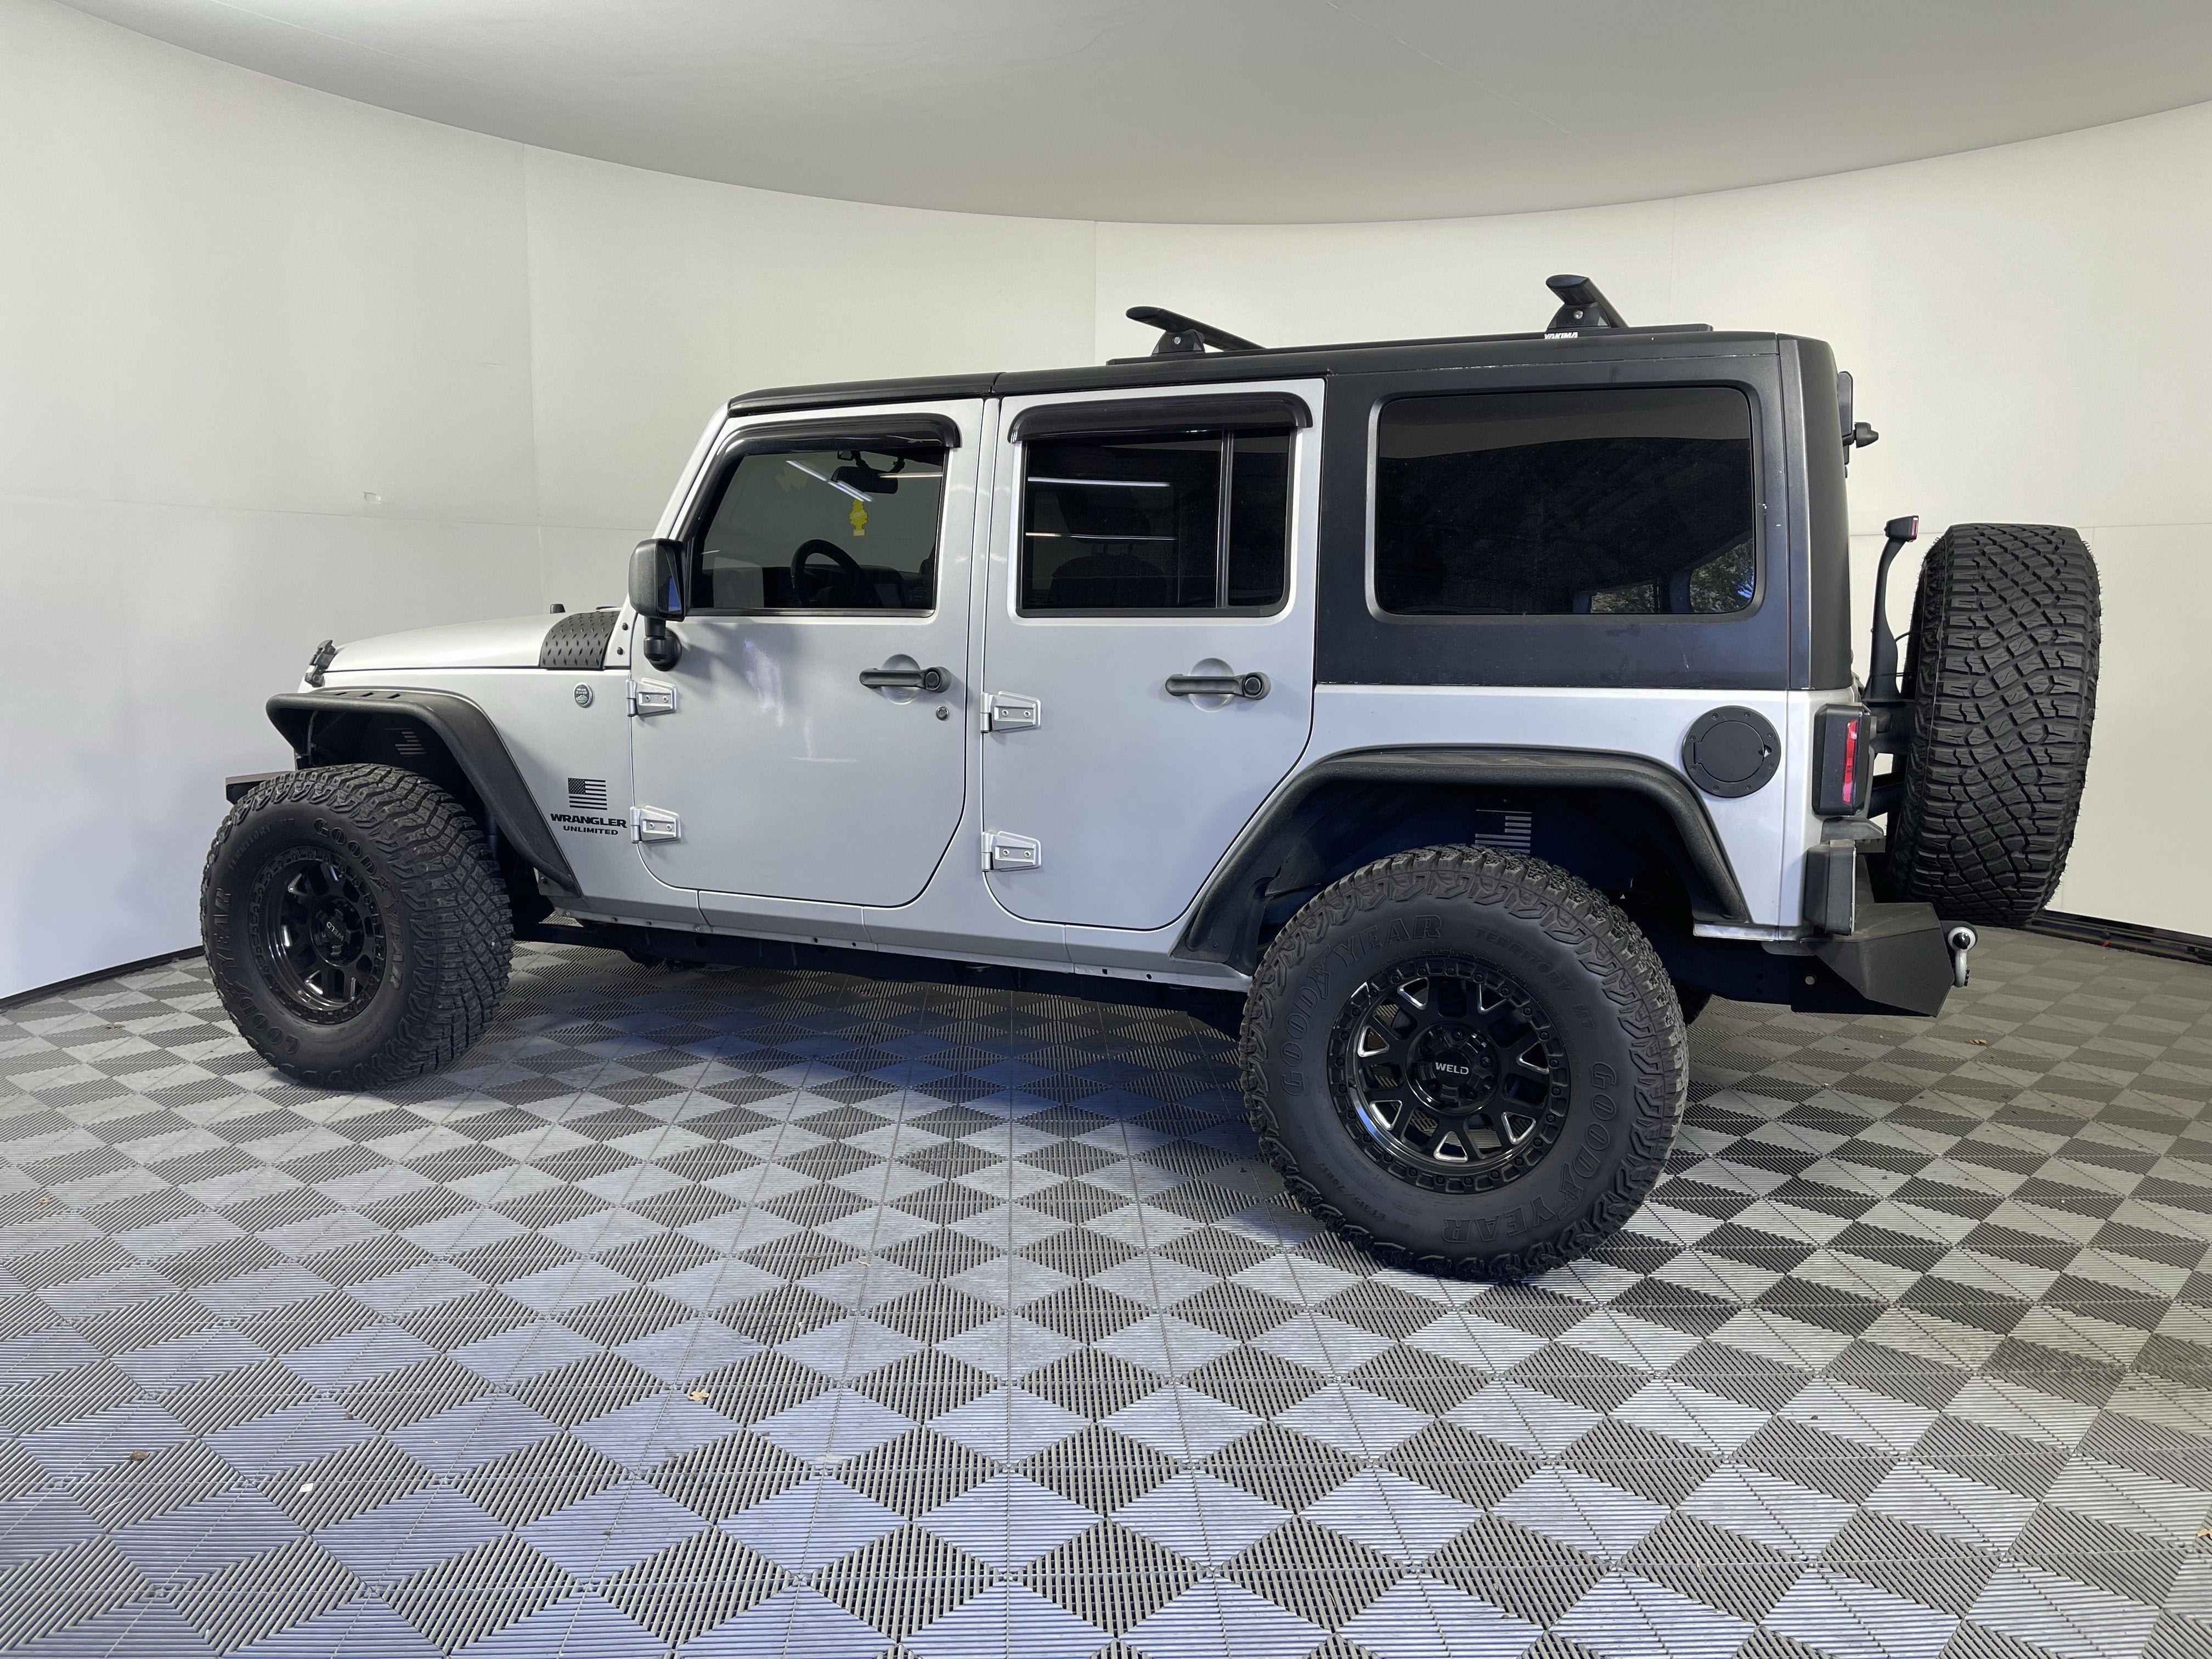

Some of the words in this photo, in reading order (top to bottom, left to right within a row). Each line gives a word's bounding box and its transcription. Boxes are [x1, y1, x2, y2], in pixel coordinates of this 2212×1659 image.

[1544, 331, 1578, 340] YAKIMA
[550, 813, 628, 828] WRANGLER
[563, 825, 618, 835] UNLIMITED
[326, 922, 344, 941] WELD
[1474, 926, 1574, 991] TERRITORY
[1435, 1062, 1469, 1075] WELD
